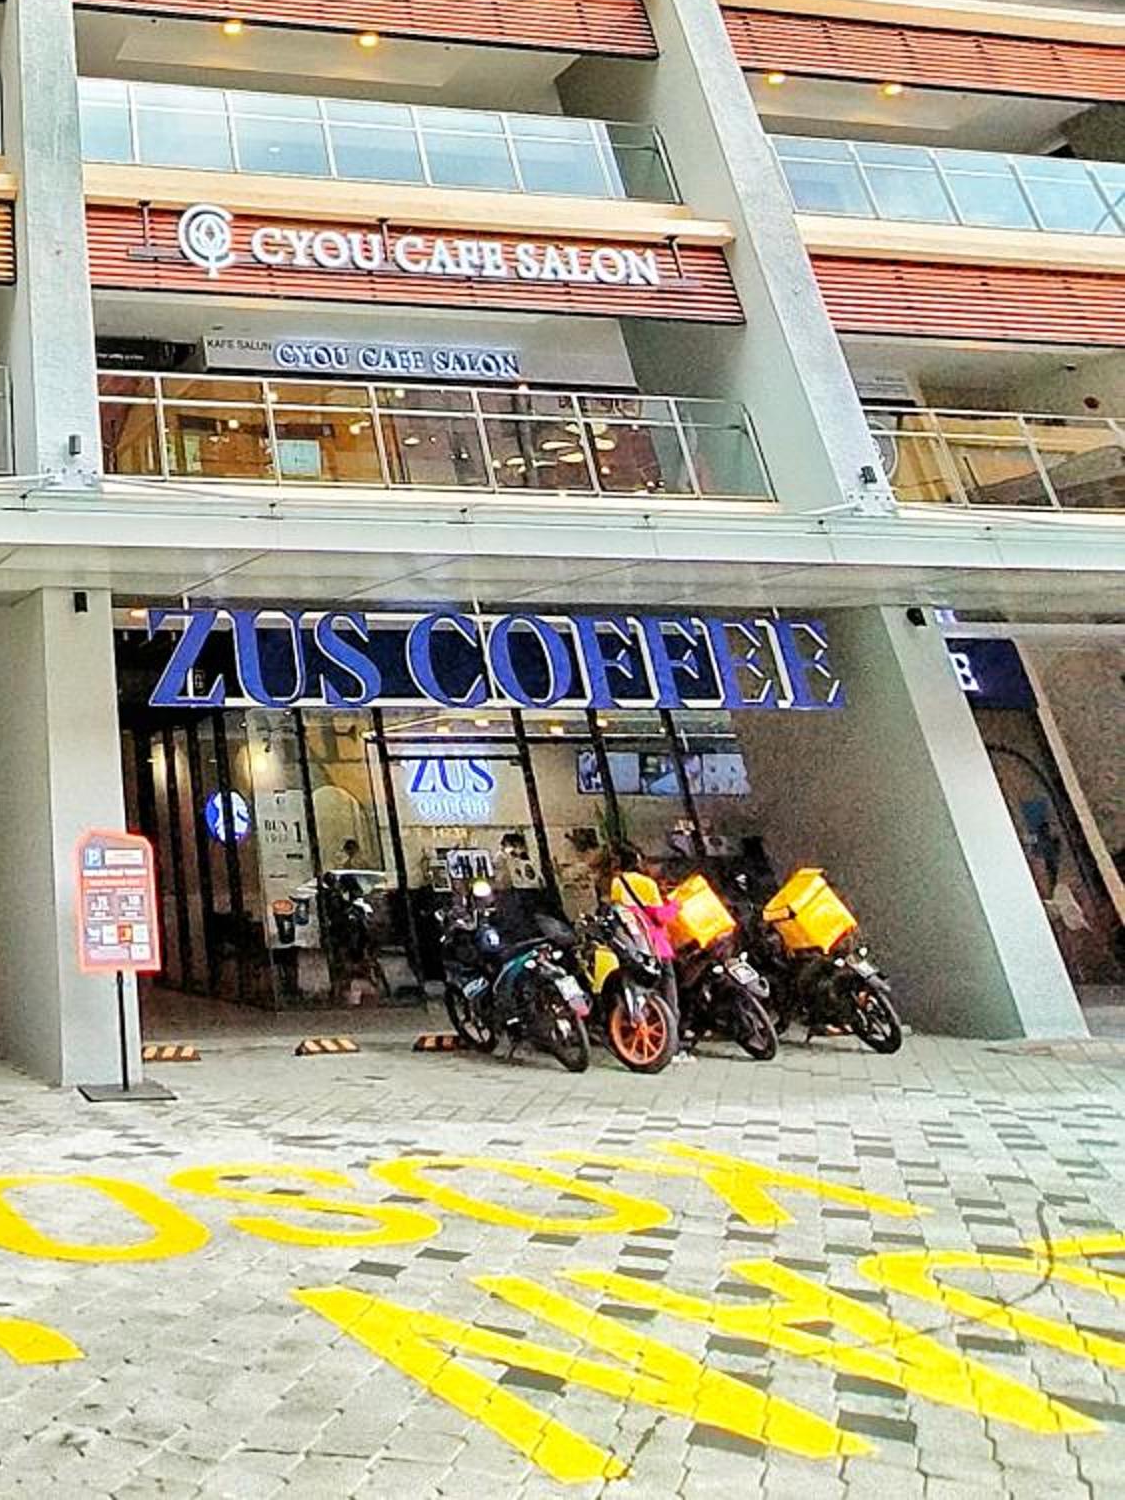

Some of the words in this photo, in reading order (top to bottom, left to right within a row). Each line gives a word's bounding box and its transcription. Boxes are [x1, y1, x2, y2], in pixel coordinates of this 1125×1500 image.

[250, 227, 385, 271] CYOU
[394, 235, 508, 276] CAFE
[515, 243, 661, 286] SALON
[276, 342, 350, 369] CYOU
[358, 347, 425, 373] CAFE
[431, 350, 521, 378] SALON
[148, 608, 382, 708] ZUS
[406, 611, 847, 710] COFFEE
[408, 756, 495, 793] ZUS
